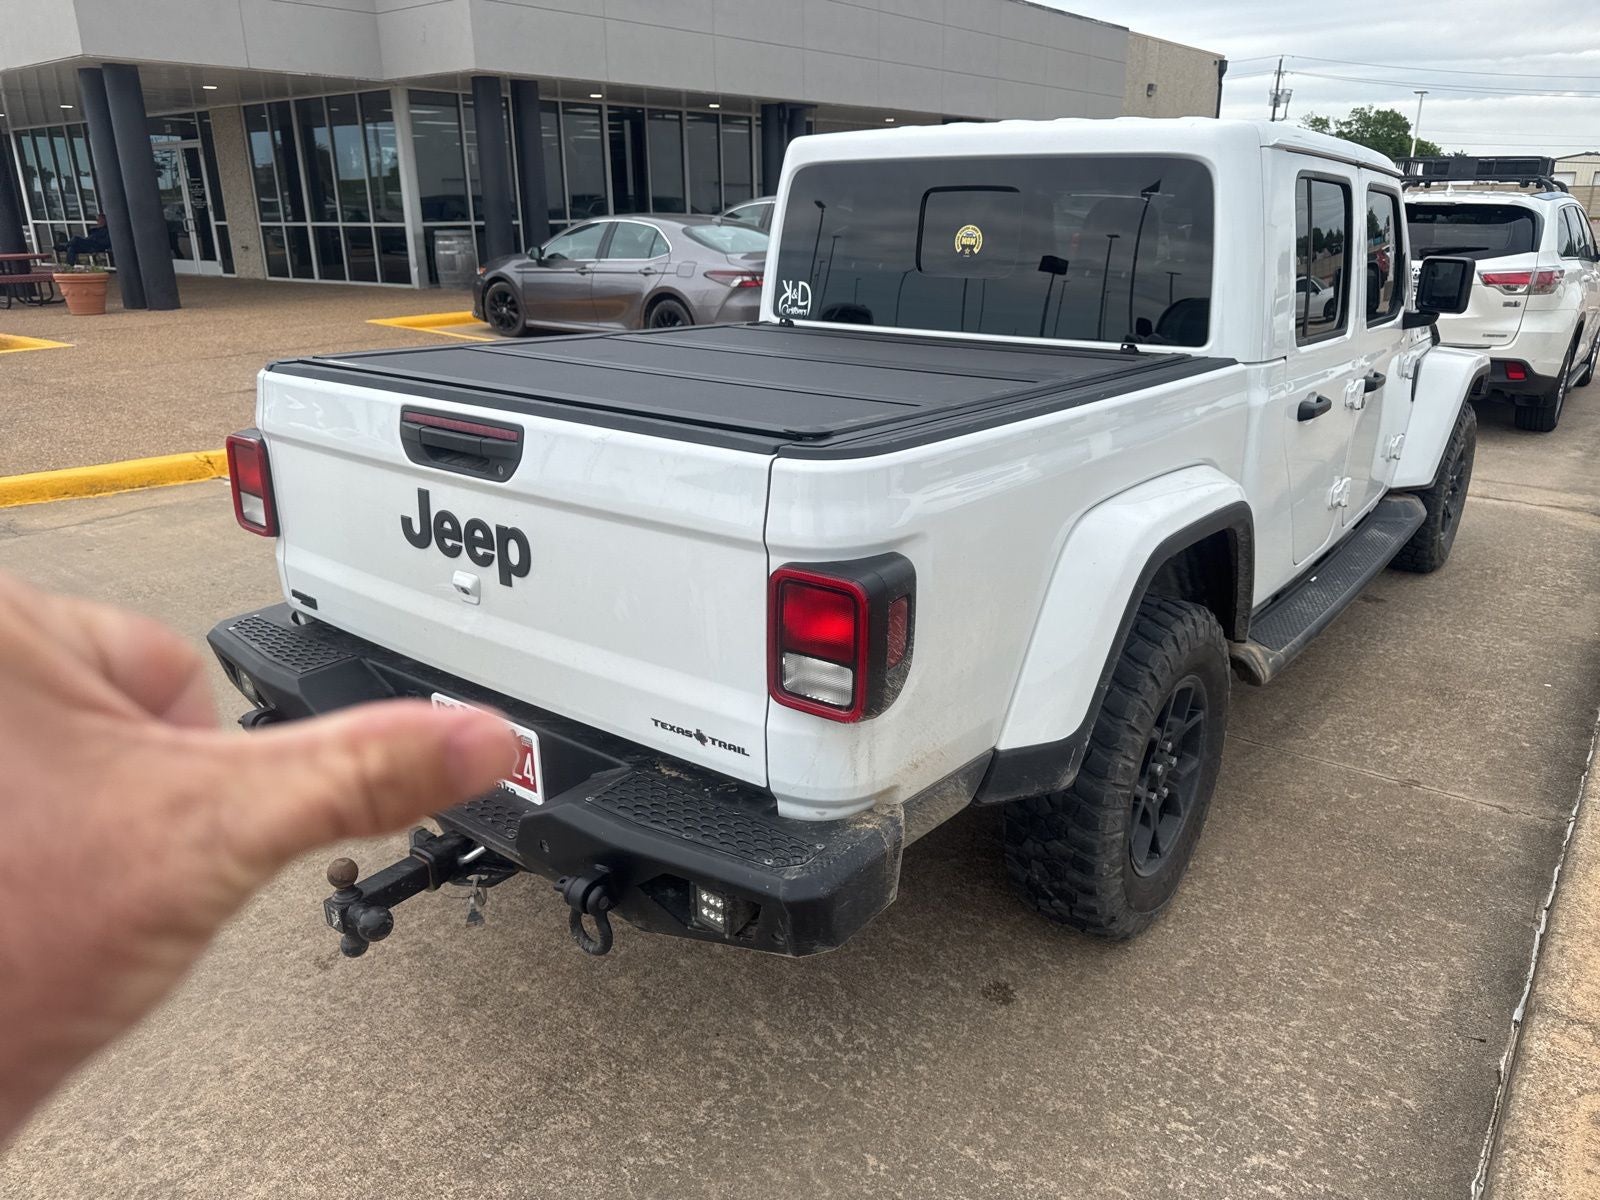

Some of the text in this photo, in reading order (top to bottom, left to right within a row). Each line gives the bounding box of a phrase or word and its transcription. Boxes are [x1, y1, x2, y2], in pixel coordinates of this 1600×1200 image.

[400, 487, 532, 588] Jeep
[650, 717, 750, 757] TEXAS TRAIL
